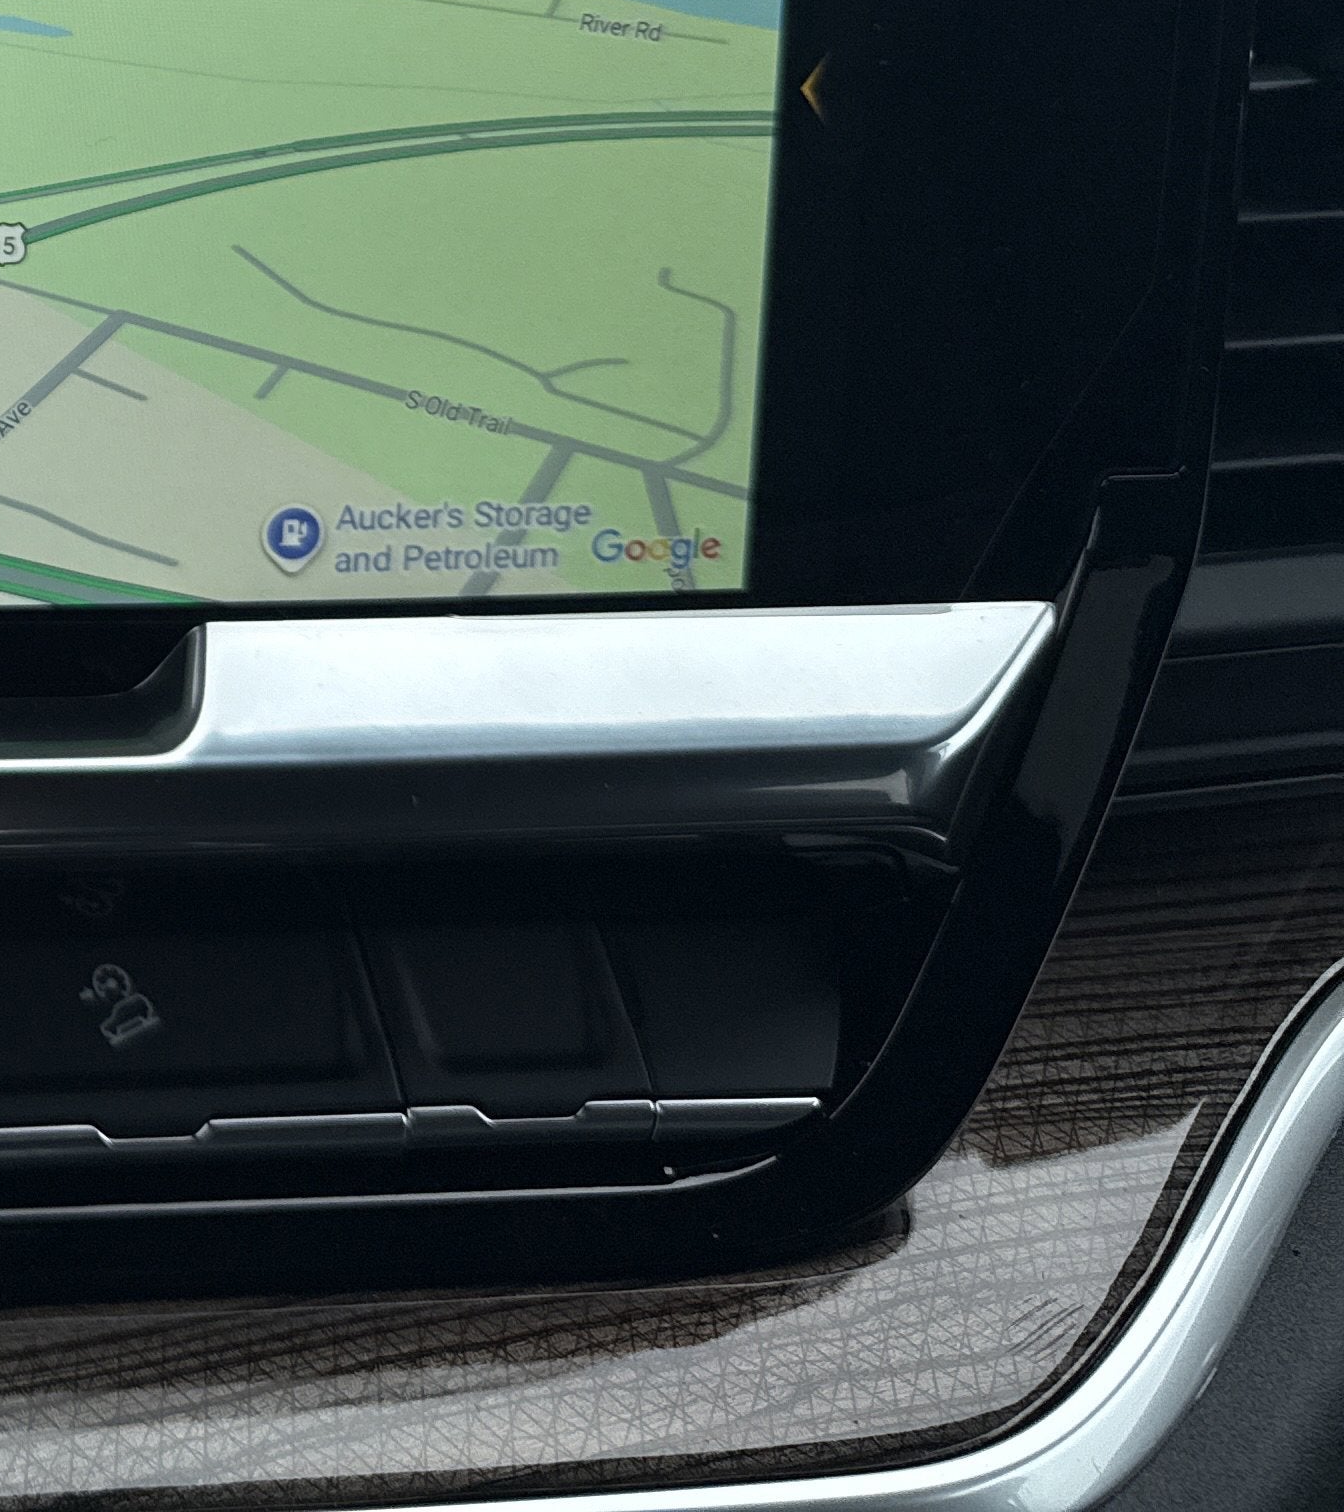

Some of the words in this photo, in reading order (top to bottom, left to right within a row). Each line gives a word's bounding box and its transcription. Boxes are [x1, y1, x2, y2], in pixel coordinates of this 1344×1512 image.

[579, 13, 631, 38] River
[634, 21, 663, 42] Rd
[405, 389, 423, 410] S
[424, 395, 462, 422] Old
[468, 405, 513, 436] Trail
[335, 501, 464, 531] Aucker's
[474, 500, 592, 533] Storage
[334, 545, 393, 573] and
[403, 543, 559, 572] Petroleum
[592, 527, 722, 569] Google
